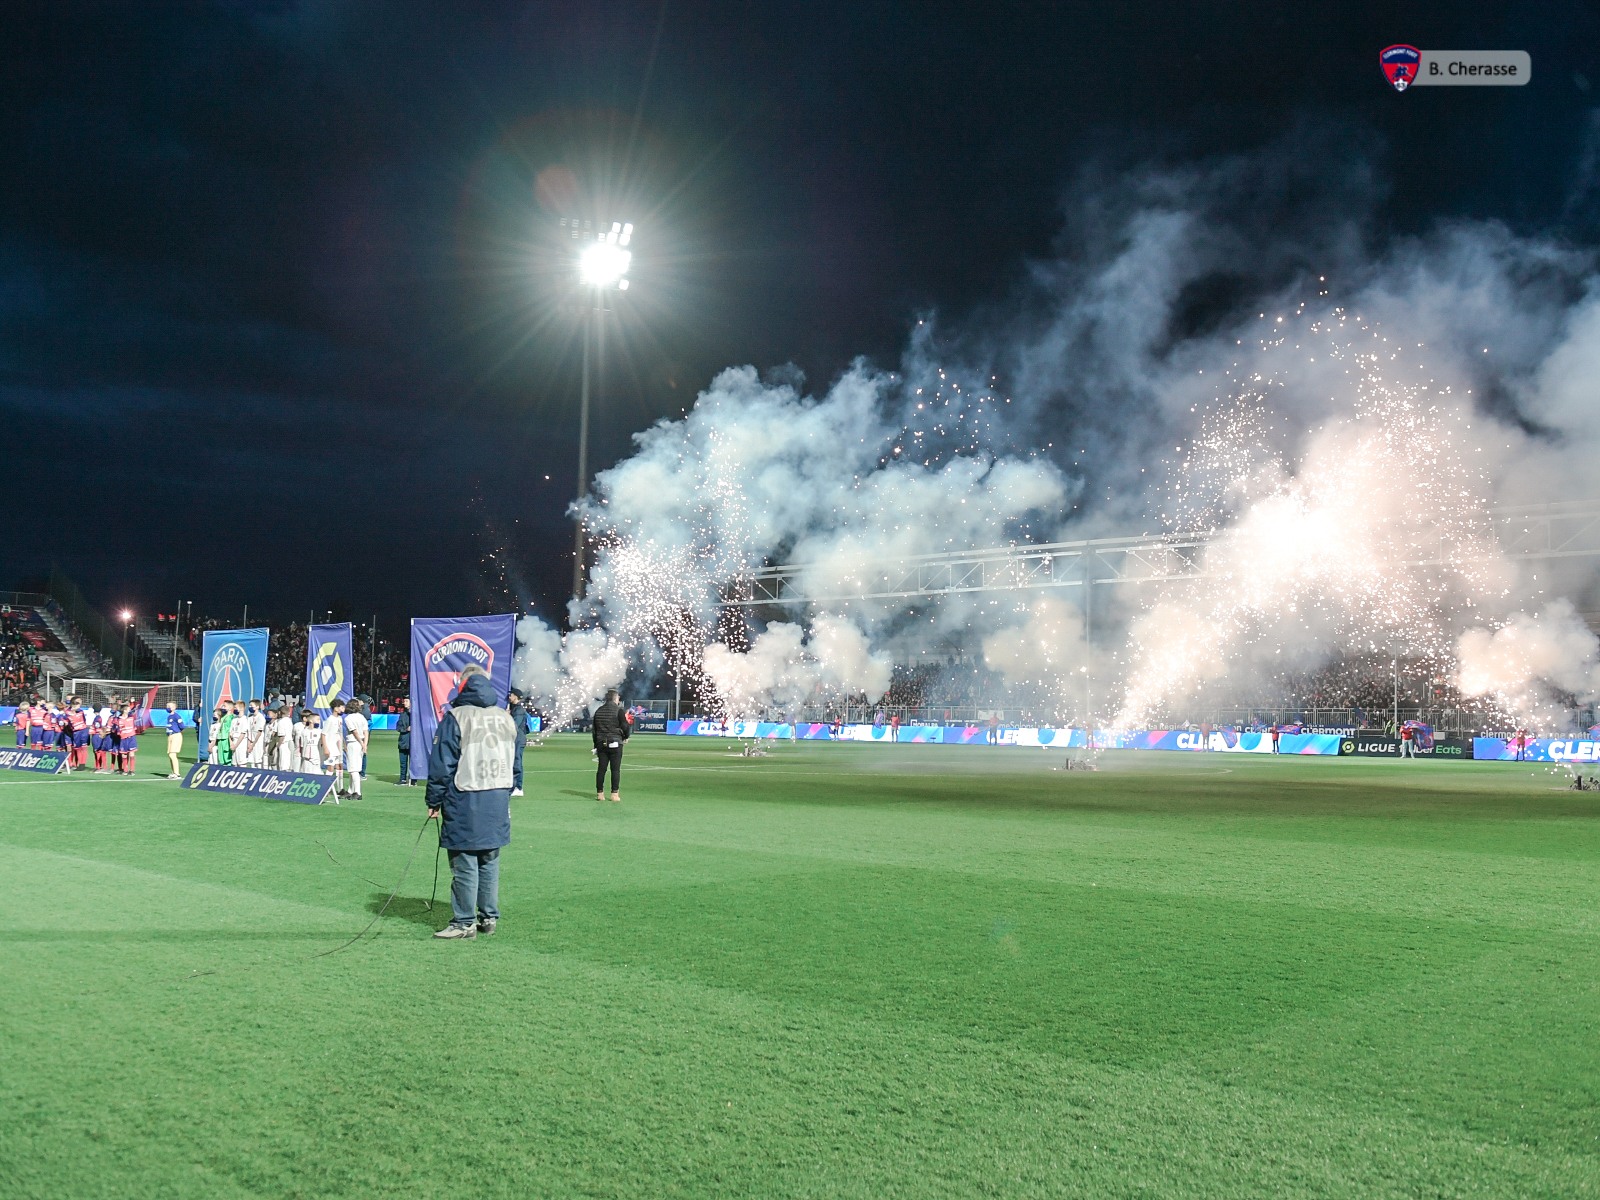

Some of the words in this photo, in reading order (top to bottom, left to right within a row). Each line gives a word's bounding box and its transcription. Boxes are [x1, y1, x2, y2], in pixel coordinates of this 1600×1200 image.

[214, 647, 245, 672] PARIS
[432, 641, 468, 664] CLERMONT
[468, 643, 488, 663] FOOT
[472, 716, 506, 729] LFP
[1160, 722, 1187, 731] Régin
[1358, 743, 1396, 753] LIGUE
[1436, 745, 1462, 754] Eats
[13, 752, 22, 766] 1
[18, 752, 41, 767] Uber
[36, 754, 59, 769] Eats
[477, 759, 499, 779] 39
[207, 770, 253, 790] LIGUE
[249, 773, 262, 792] 1
[259, 774, 291, 795] Uber
[286, 778, 321, 798] Eats
